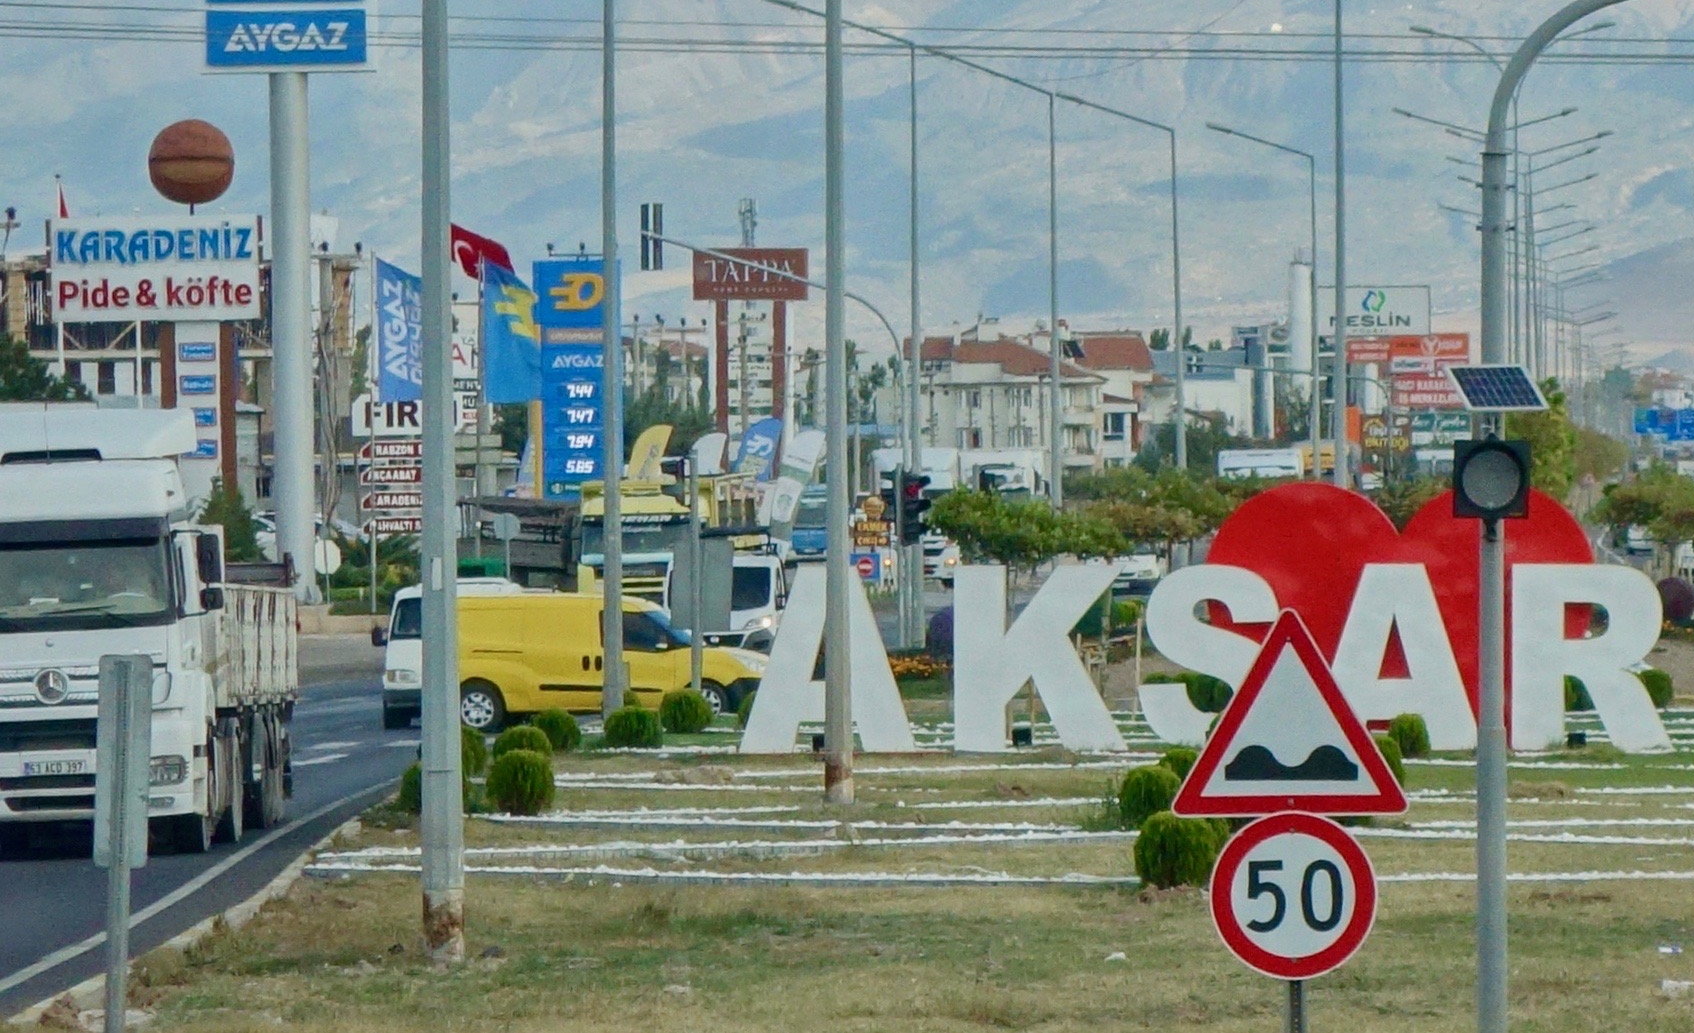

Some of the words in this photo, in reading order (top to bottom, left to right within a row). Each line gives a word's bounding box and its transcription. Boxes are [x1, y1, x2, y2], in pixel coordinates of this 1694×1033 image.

[224, 22, 348, 52] AYGAZ
[56, 221, 252, 264] KARADENİZ
[59, 278, 130, 309] Pide
[136, 279, 157, 307] &
[166, 276, 252, 307] köfte
[383, 279, 409, 380] AYGAZ
[552, 355, 605, 368] AYGAZ
[372, 444, 414, 457] RABZON
[1246, 859, 1344, 933] 50
